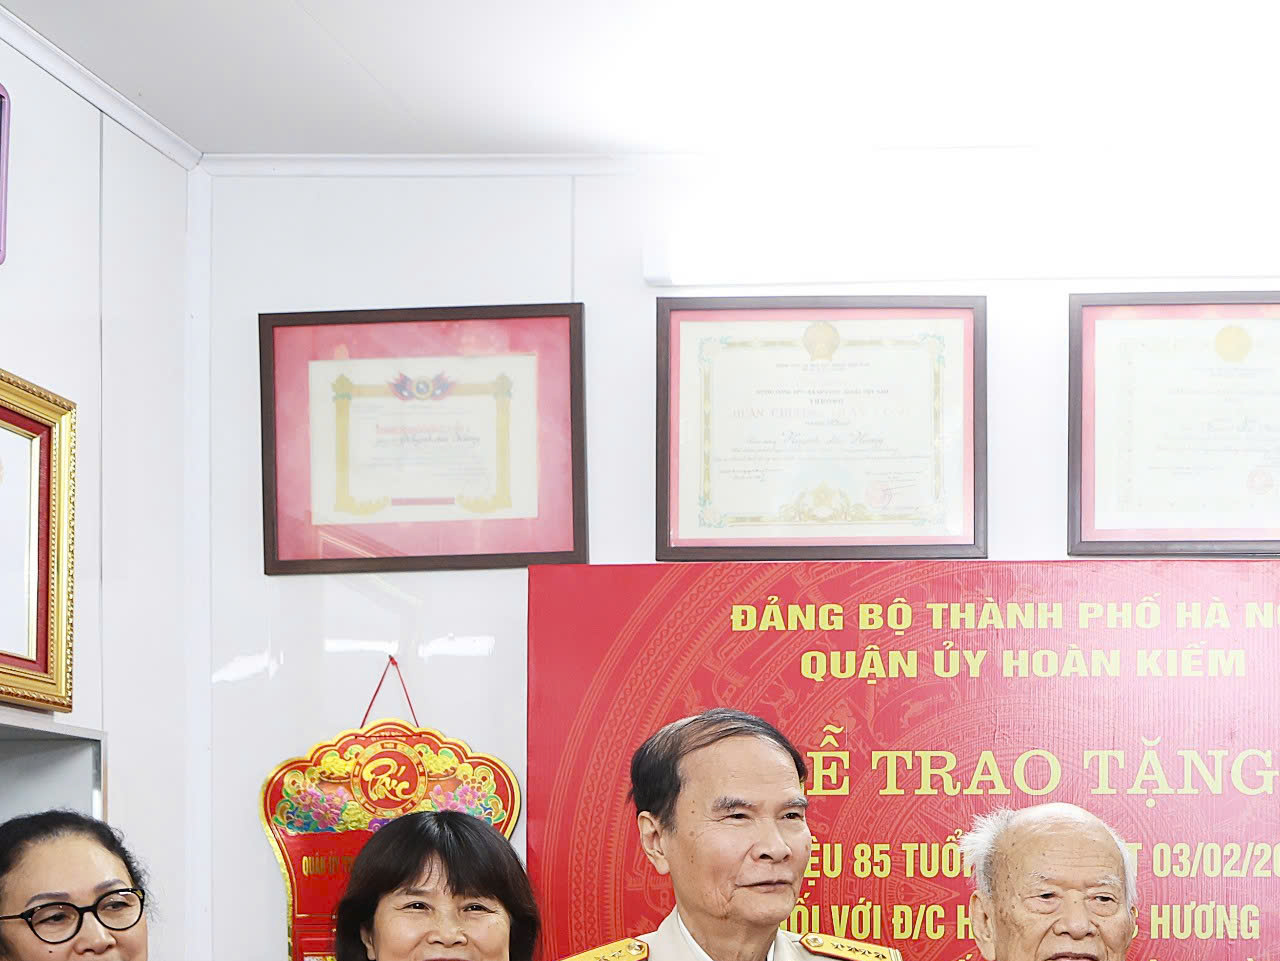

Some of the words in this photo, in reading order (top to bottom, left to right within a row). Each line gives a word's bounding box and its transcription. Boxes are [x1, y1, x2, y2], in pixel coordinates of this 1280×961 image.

[730, 595, 844, 632] ĐẢNG
[858, 597, 913, 636] BỘ
[926, 597, 1063, 630] THÀNH
[1078, 592, 1162, 630] PHỐ
[1175, 596, 1231, 630] HÀ
[800, 645, 918, 685] QUẬN
[933, 641, 988, 679] ỦY
[1002, 642, 1121, 679] HOÀN
[1136, 641, 1246, 678] KIẾM
[806, 724, 850, 797] Ễ
[871, 749, 1062, 797] TRAO
[1083, 735, 1280, 809] TẶNG
[853, 843, 891, 878] 85
[780, 892, 820, 935] ỐI
[831, 897, 882, 940] VỚI
[891, 904, 945, 941] Đ/C
[1150, 900, 1261, 941] HƯƠNG
